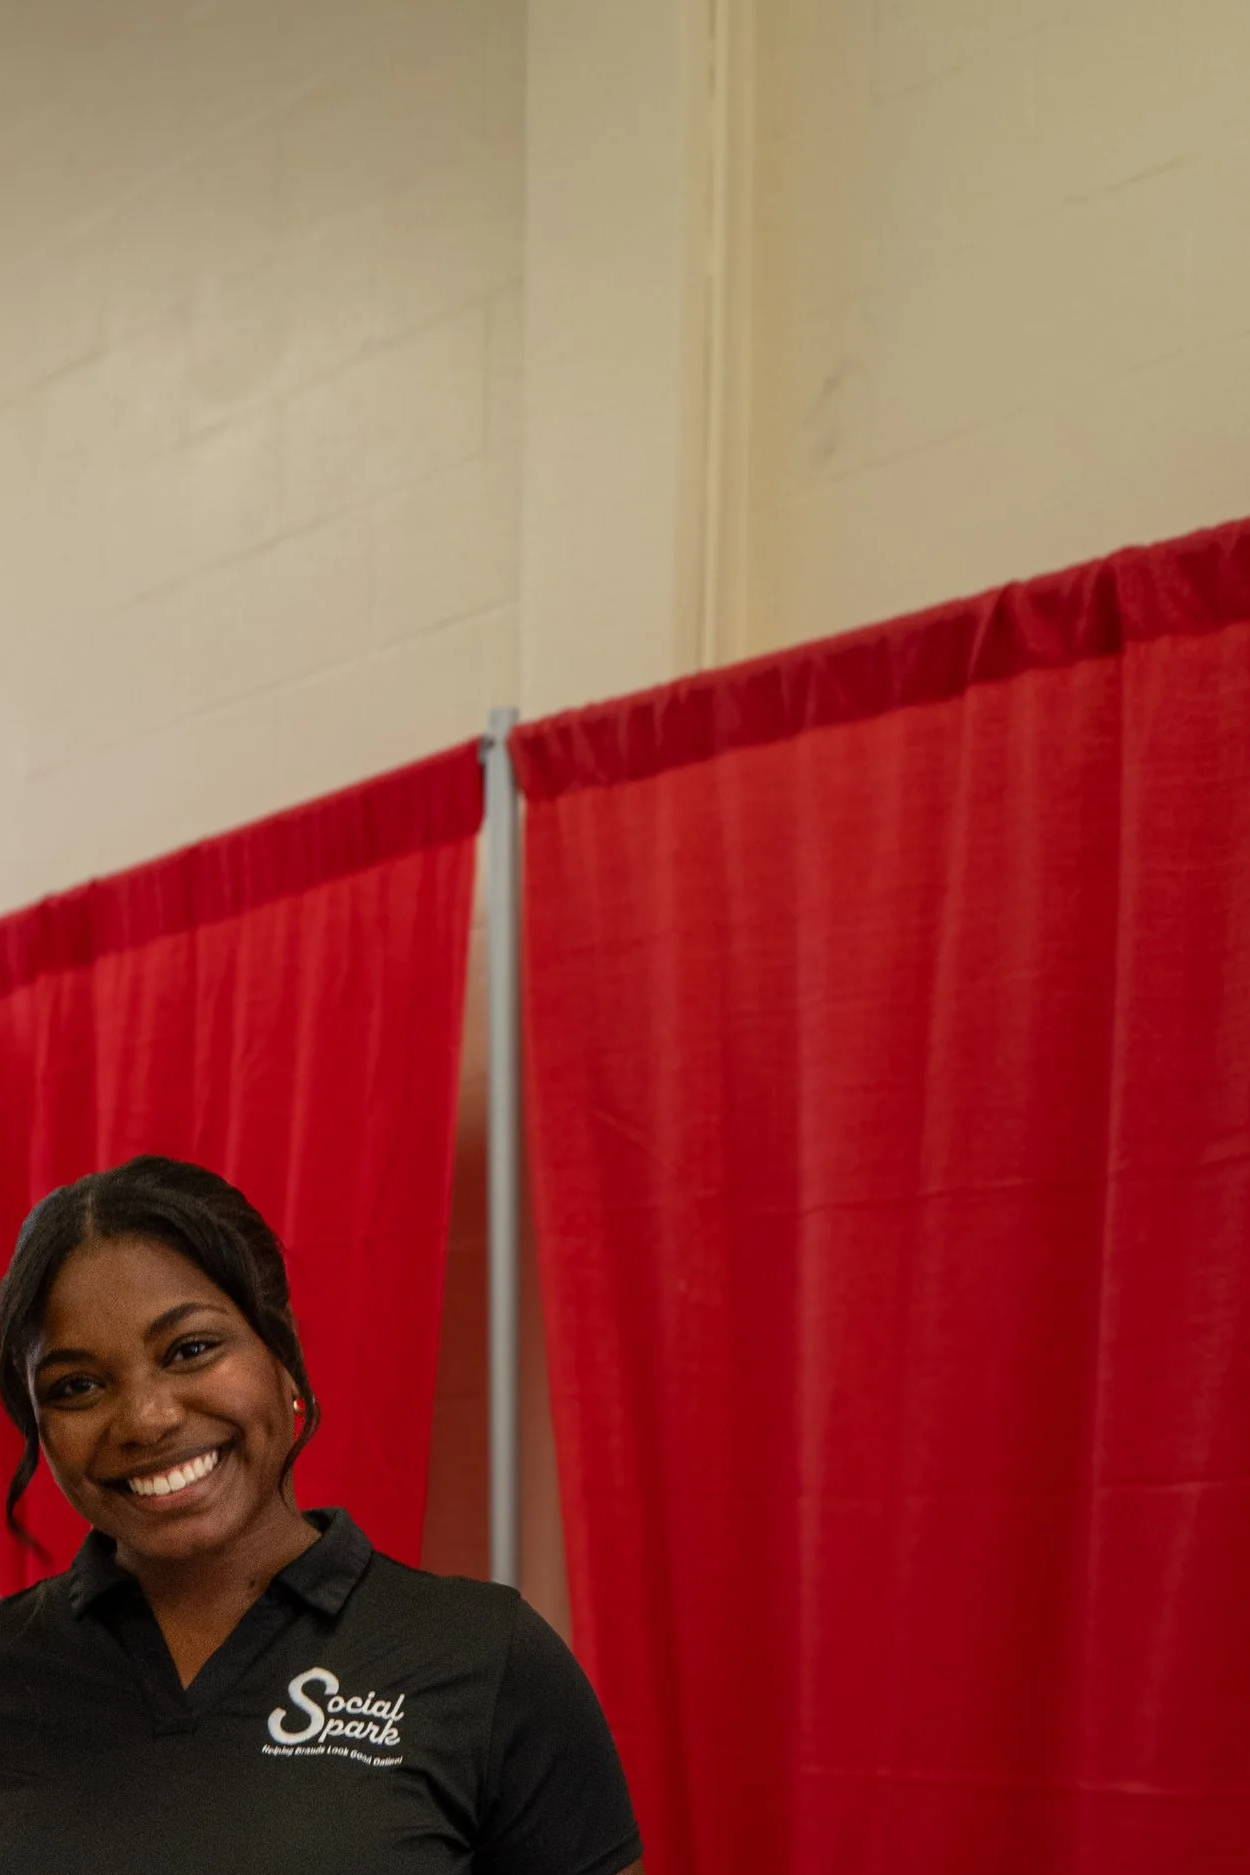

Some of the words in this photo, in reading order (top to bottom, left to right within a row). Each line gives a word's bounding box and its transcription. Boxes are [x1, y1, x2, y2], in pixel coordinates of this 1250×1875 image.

[267, 1666, 405, 1745] Social
[261, 1744, 293, 1757] Helping
[294, 1745, 325, 1756] Brands
[327, 1745, 349, 1757] Look
[350, 1749, 372, 1764] Good
